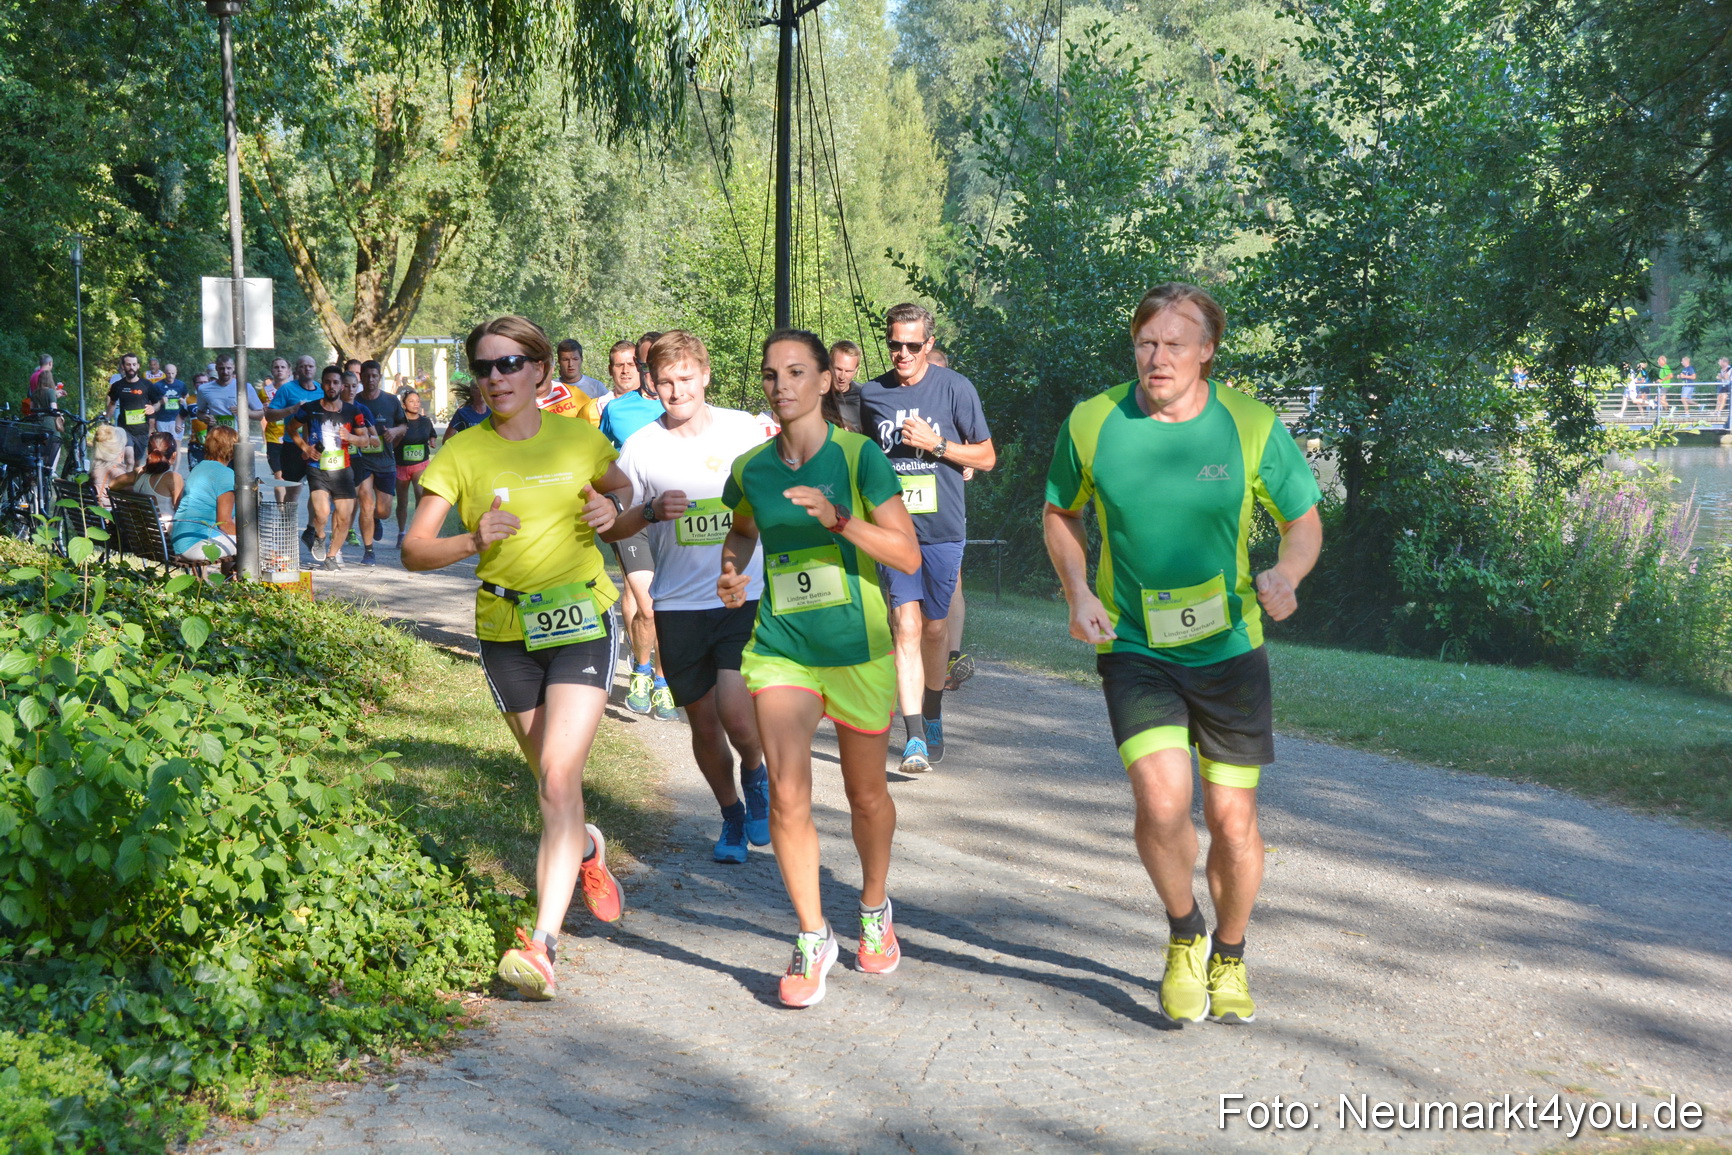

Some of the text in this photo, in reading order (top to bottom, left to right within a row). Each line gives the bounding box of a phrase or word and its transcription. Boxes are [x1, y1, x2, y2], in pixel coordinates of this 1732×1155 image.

[406, 449, 423, 457] 1706
[1197, 464, 1229, 478] AOK
[684, 512, 732, 533] 1014
[797, 572, 811, 593] 9
[787, 591, 831, 603] Lindner Bettina
[537, 605, 583, 632] 920
[1181, 608, 1196, 627] 6
[1163, 620, 1215, 638] Lindner Gerhard
